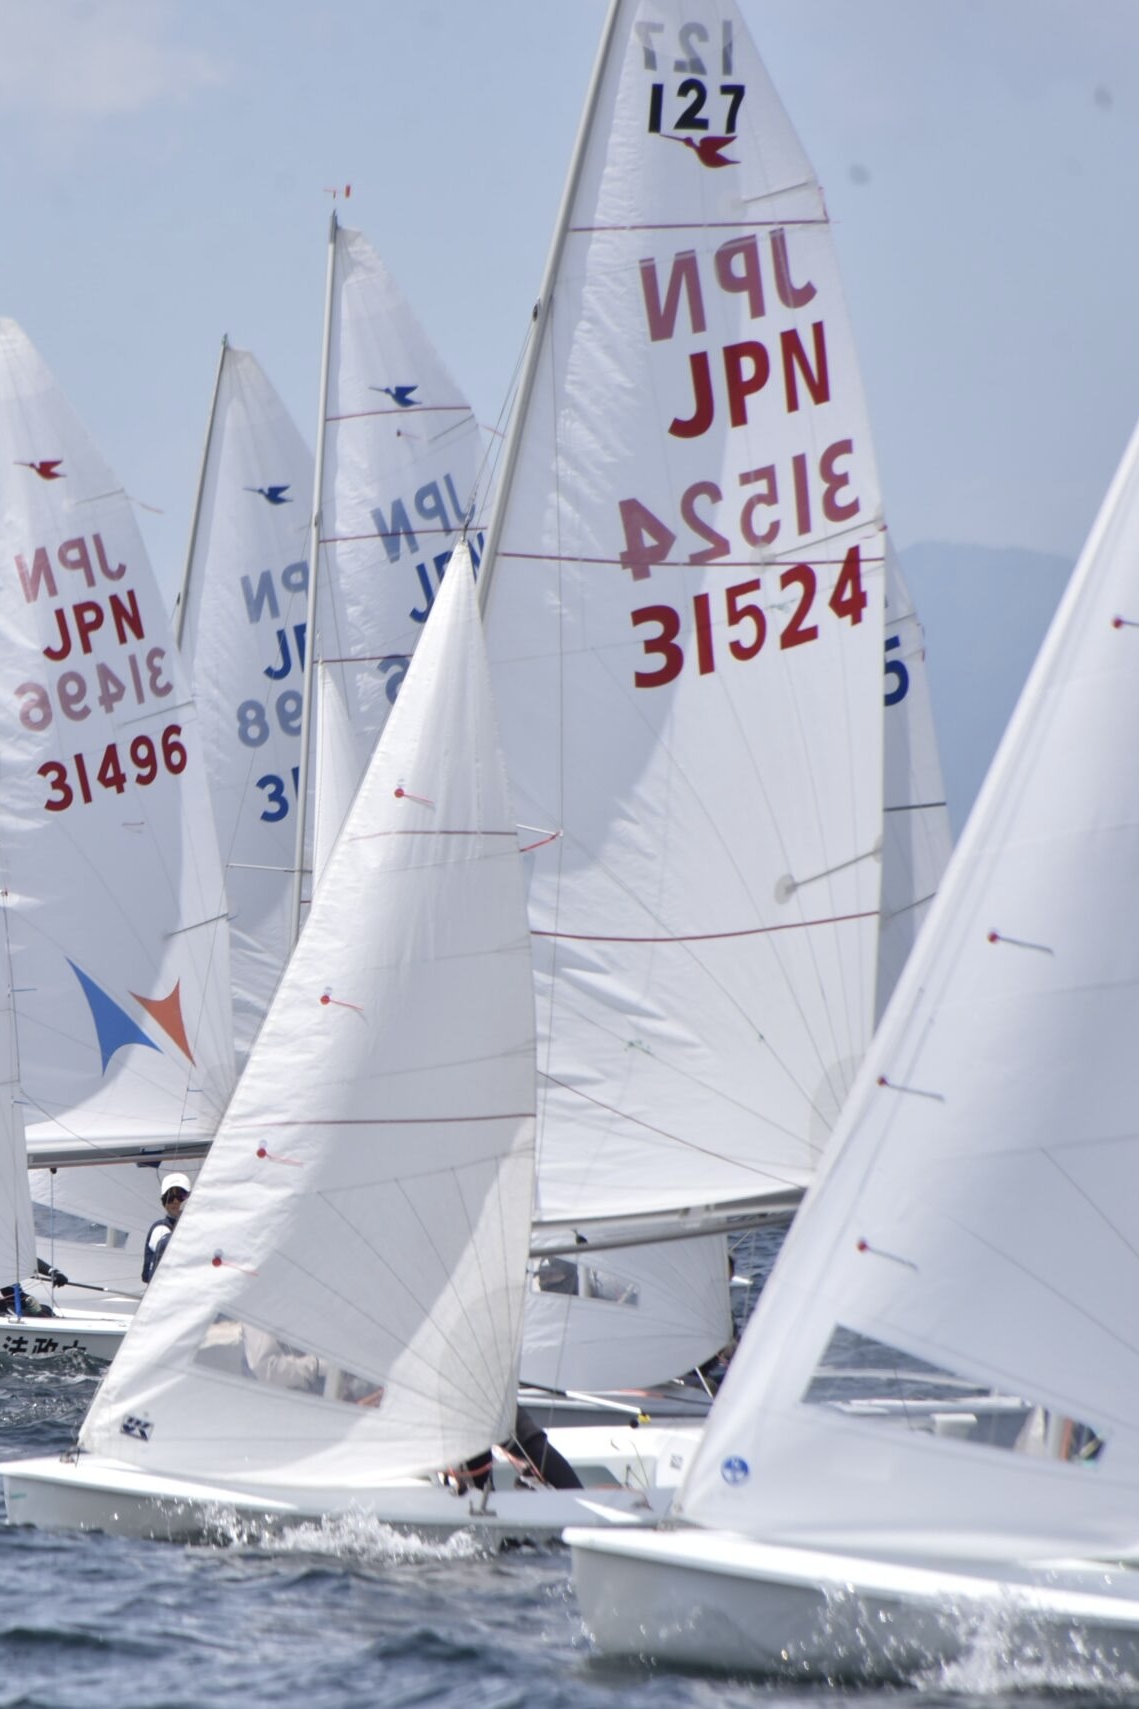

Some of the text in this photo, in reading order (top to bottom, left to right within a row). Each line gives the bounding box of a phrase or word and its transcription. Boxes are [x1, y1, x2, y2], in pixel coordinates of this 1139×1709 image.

[648, 79, 745, 134] 127
[668, 320, 831, 439] JPN
[42, 590, 145, 662] JPN
[630, 544, 867, 689] 31524
[36, 724, 188, 812] 31496
